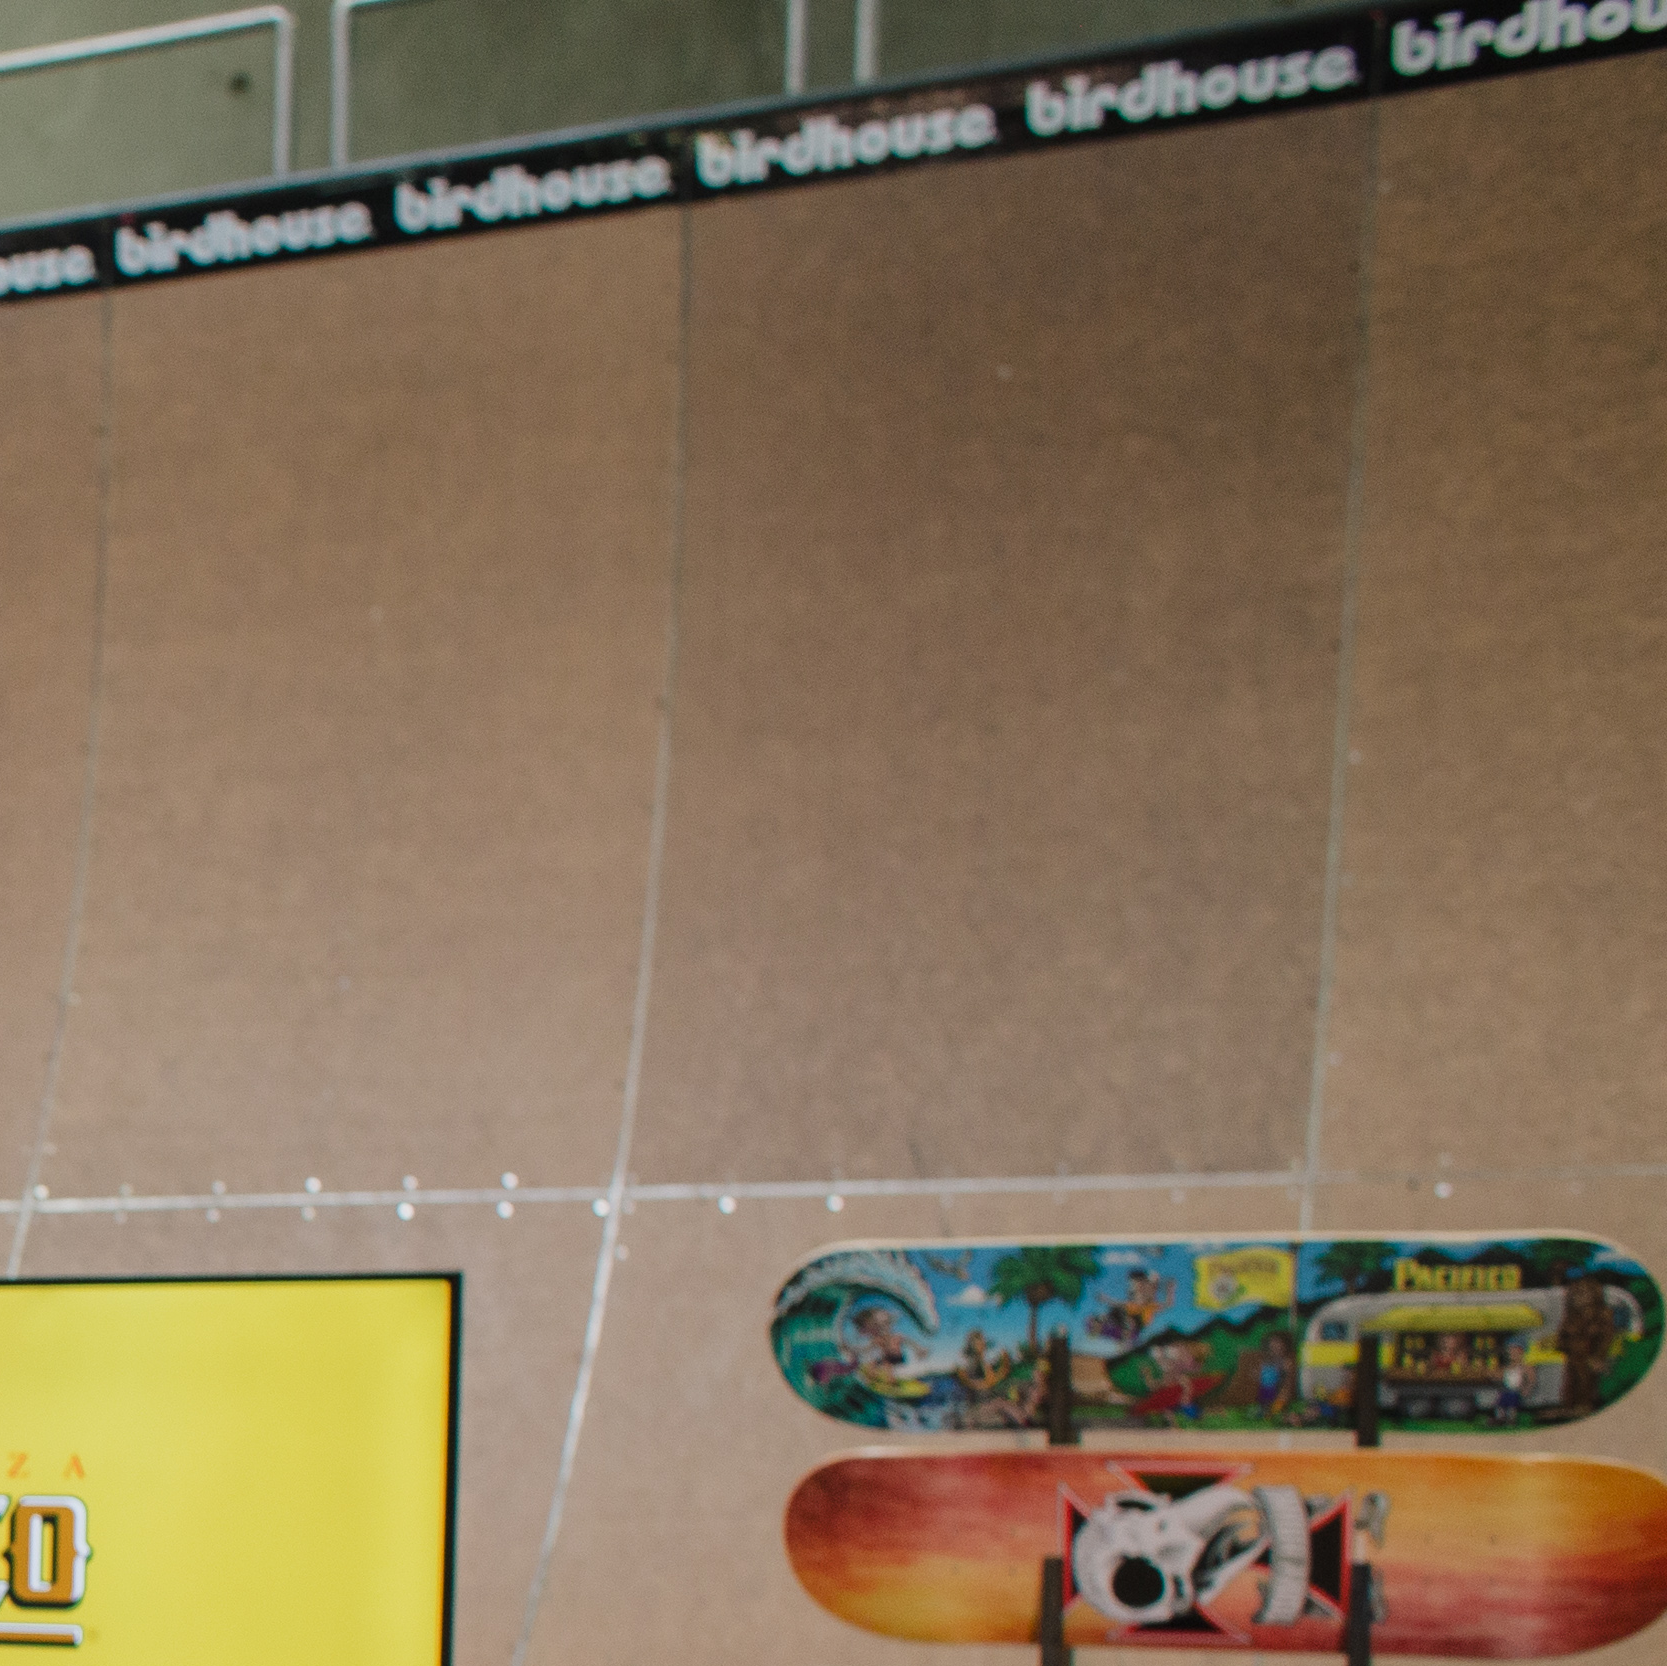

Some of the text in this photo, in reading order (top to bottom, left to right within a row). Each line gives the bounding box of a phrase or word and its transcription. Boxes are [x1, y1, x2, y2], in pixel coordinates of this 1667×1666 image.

[114, 200, 373, 277] birdhouse
[394, 154, 671, 235] birdhouse
[694, 102, 999, 189] birdhouse
[1023, 44, 1362, 138] birdhouse
